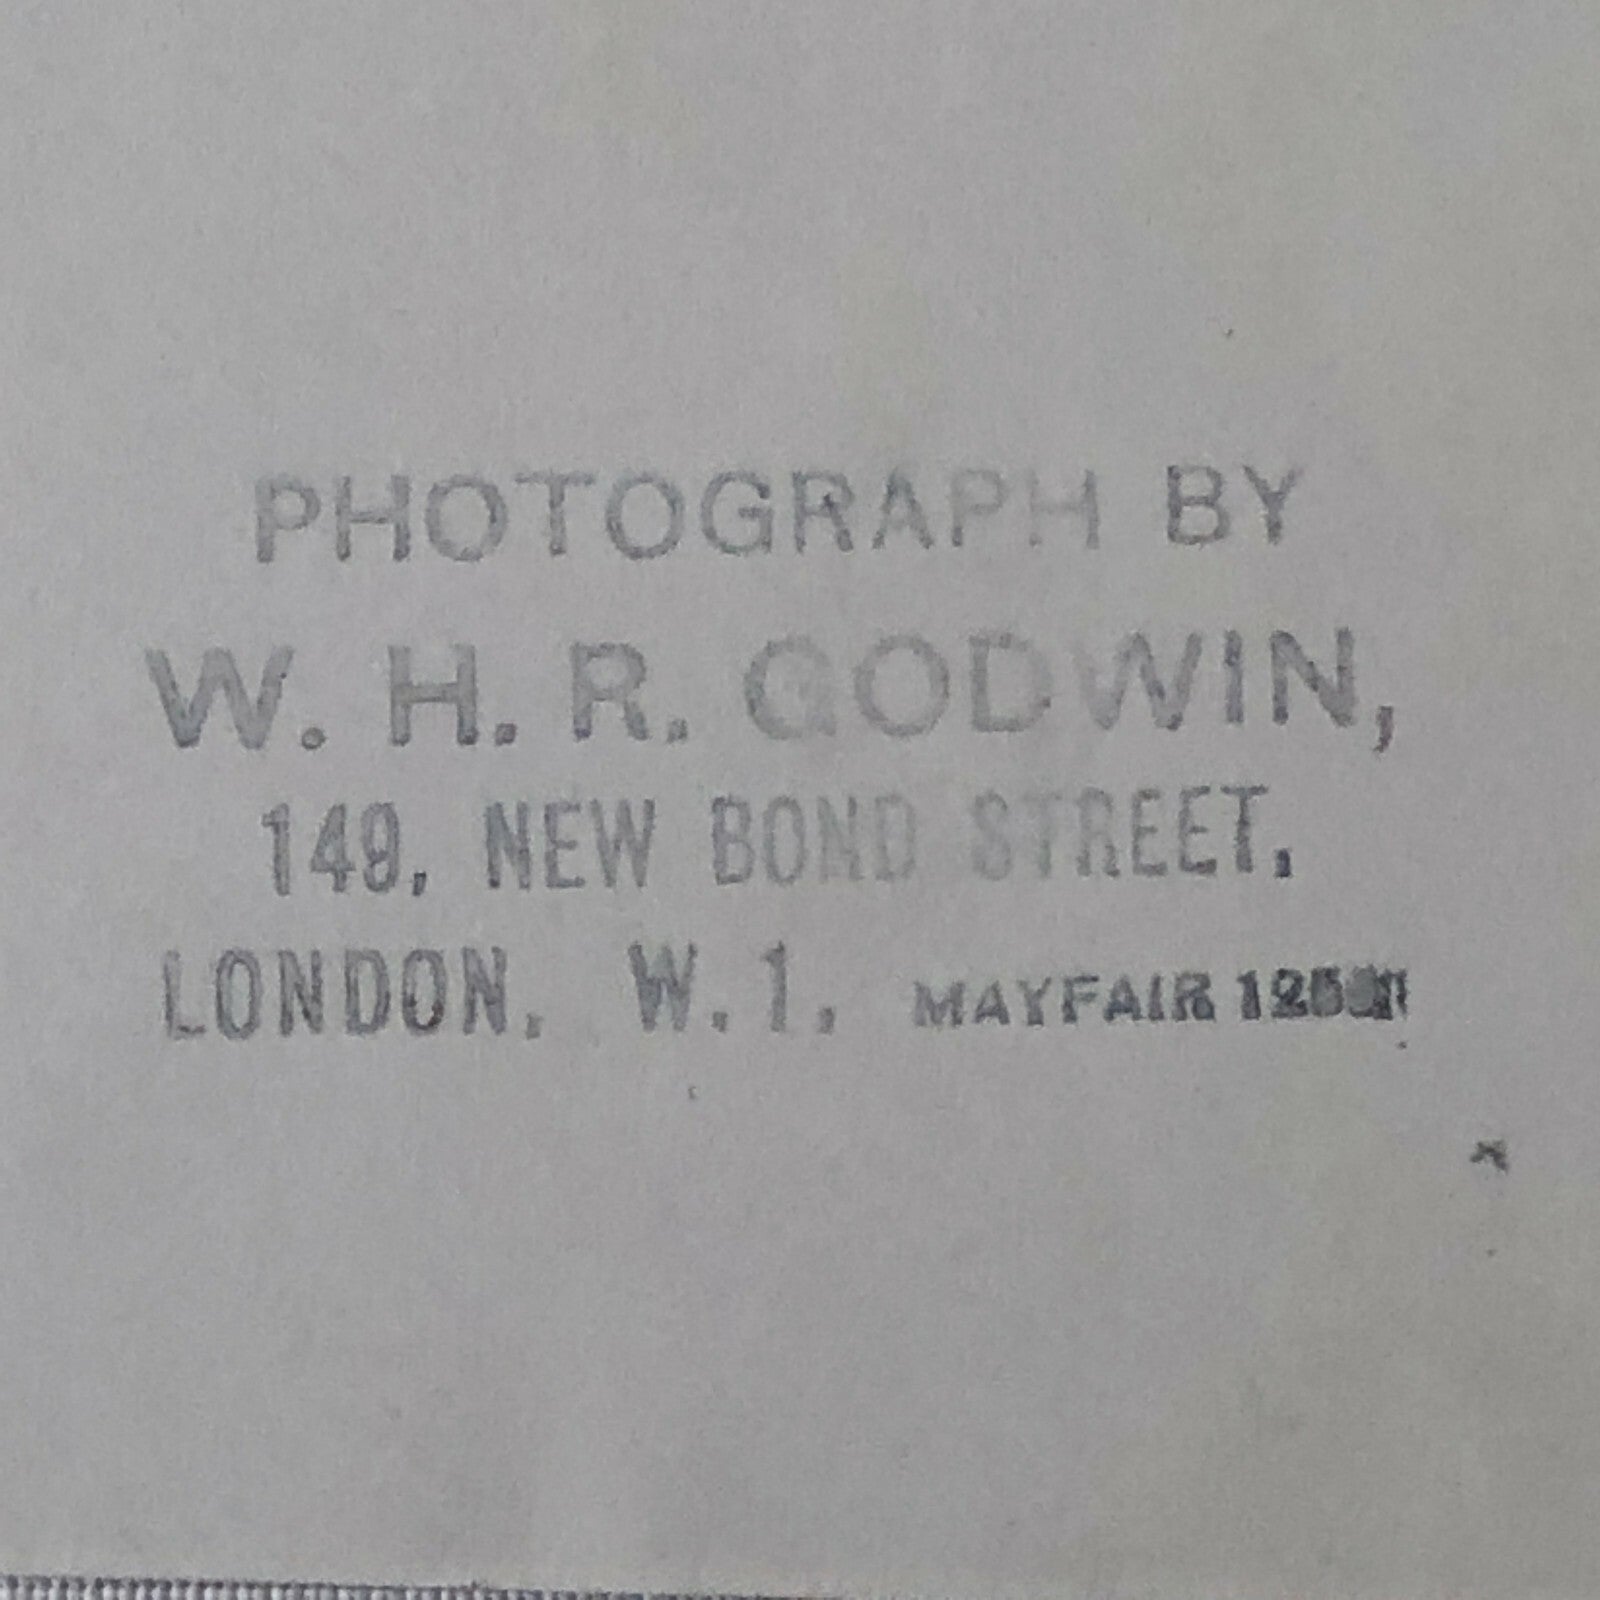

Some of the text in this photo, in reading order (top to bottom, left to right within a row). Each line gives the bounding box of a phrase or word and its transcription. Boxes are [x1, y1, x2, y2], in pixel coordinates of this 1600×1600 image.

[254, 463, 1304, 565] PHOTOGRAPH BY
[743, 626, 1396, 758] GODWIN,
[483, 797, 657, 892] NEW
[710, 792, 916, 886] BOND
[913, 967, 1216, 1030] MAYFAIR
